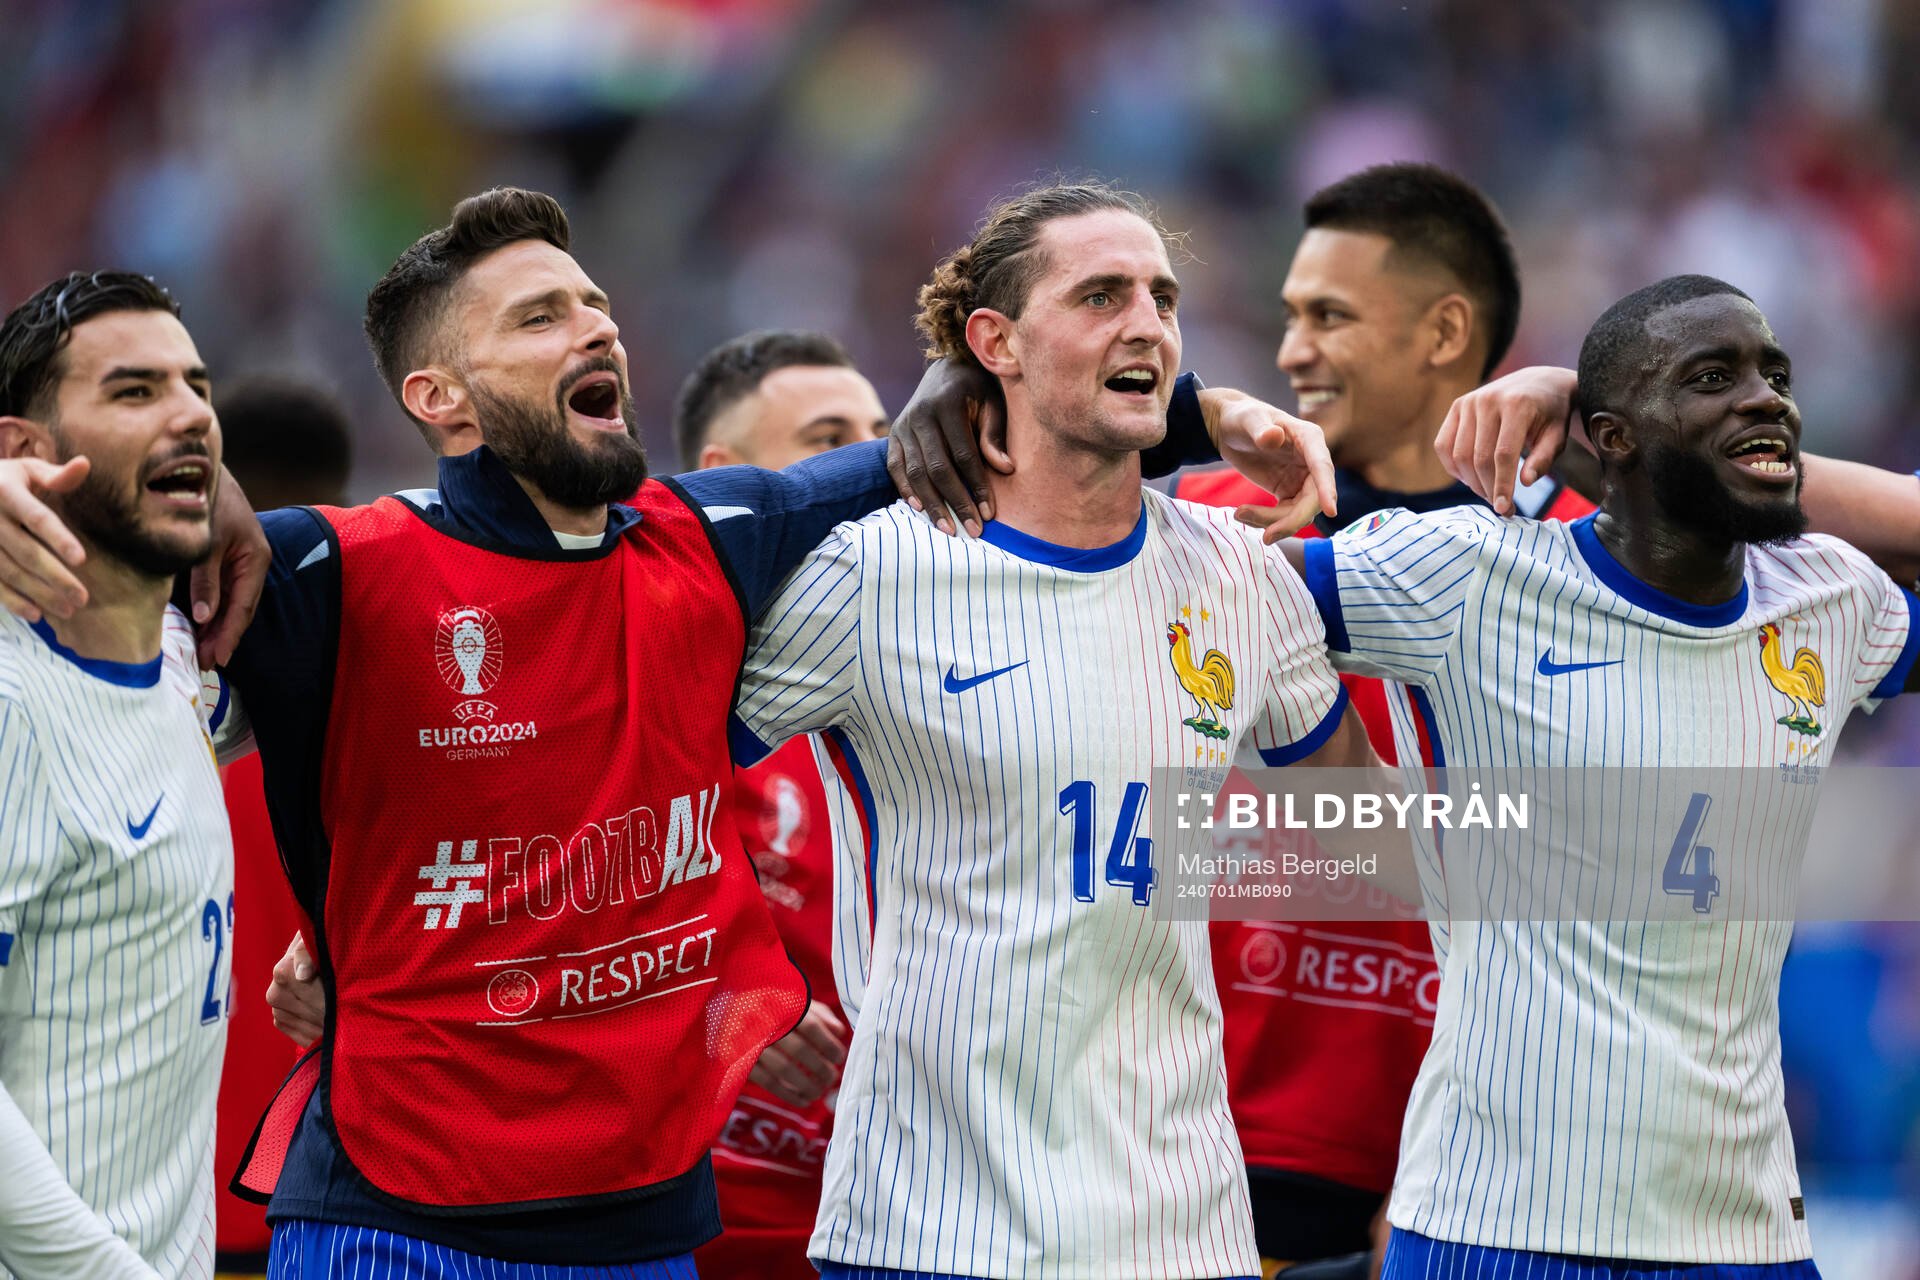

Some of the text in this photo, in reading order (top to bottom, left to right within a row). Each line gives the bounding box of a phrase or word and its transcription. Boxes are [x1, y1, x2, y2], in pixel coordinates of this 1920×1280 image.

[418, 720, 538, 747] EURO2024
[455, 704, 495, 720] UEFA
[446, 746, 512, 761] GERMANY
[413, 783, 722, 930] #FOOTBALL
[1058, 780, 1160, 907] 14
[1662, 792, 1720, 914] 4
[201, 890, 236, 1027] 2
[560, 927, 718, 1007] RESPECT
[1296, 945, 1439, 1012] RESPC
